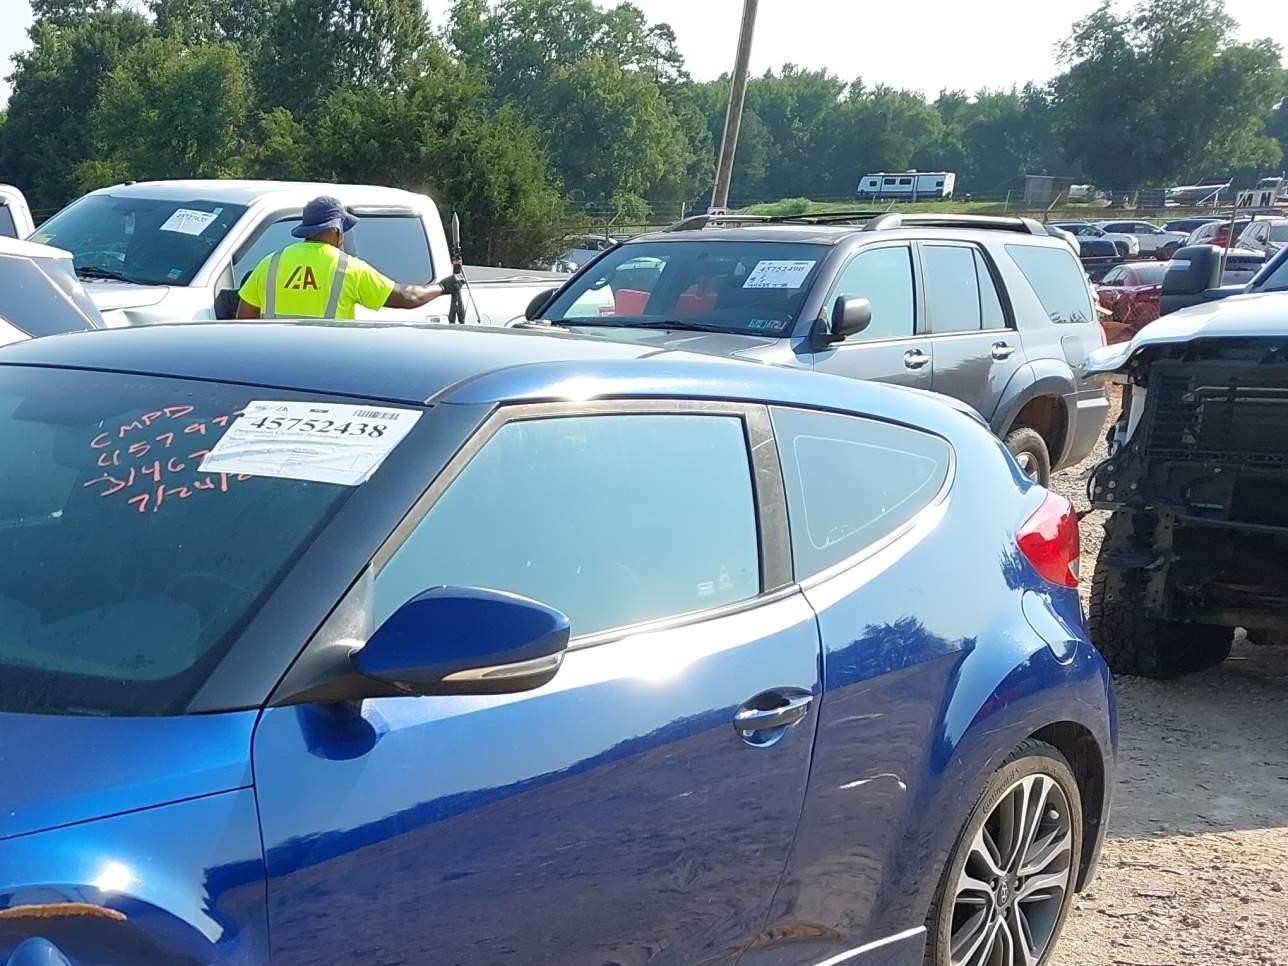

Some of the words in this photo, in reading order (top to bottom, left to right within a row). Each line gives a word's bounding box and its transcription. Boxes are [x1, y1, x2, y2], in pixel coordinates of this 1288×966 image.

[1260, 191, 1271, 207] N
[90, 405, 194, 448] CMPD
[250, 415, 388, 438] 45752438
